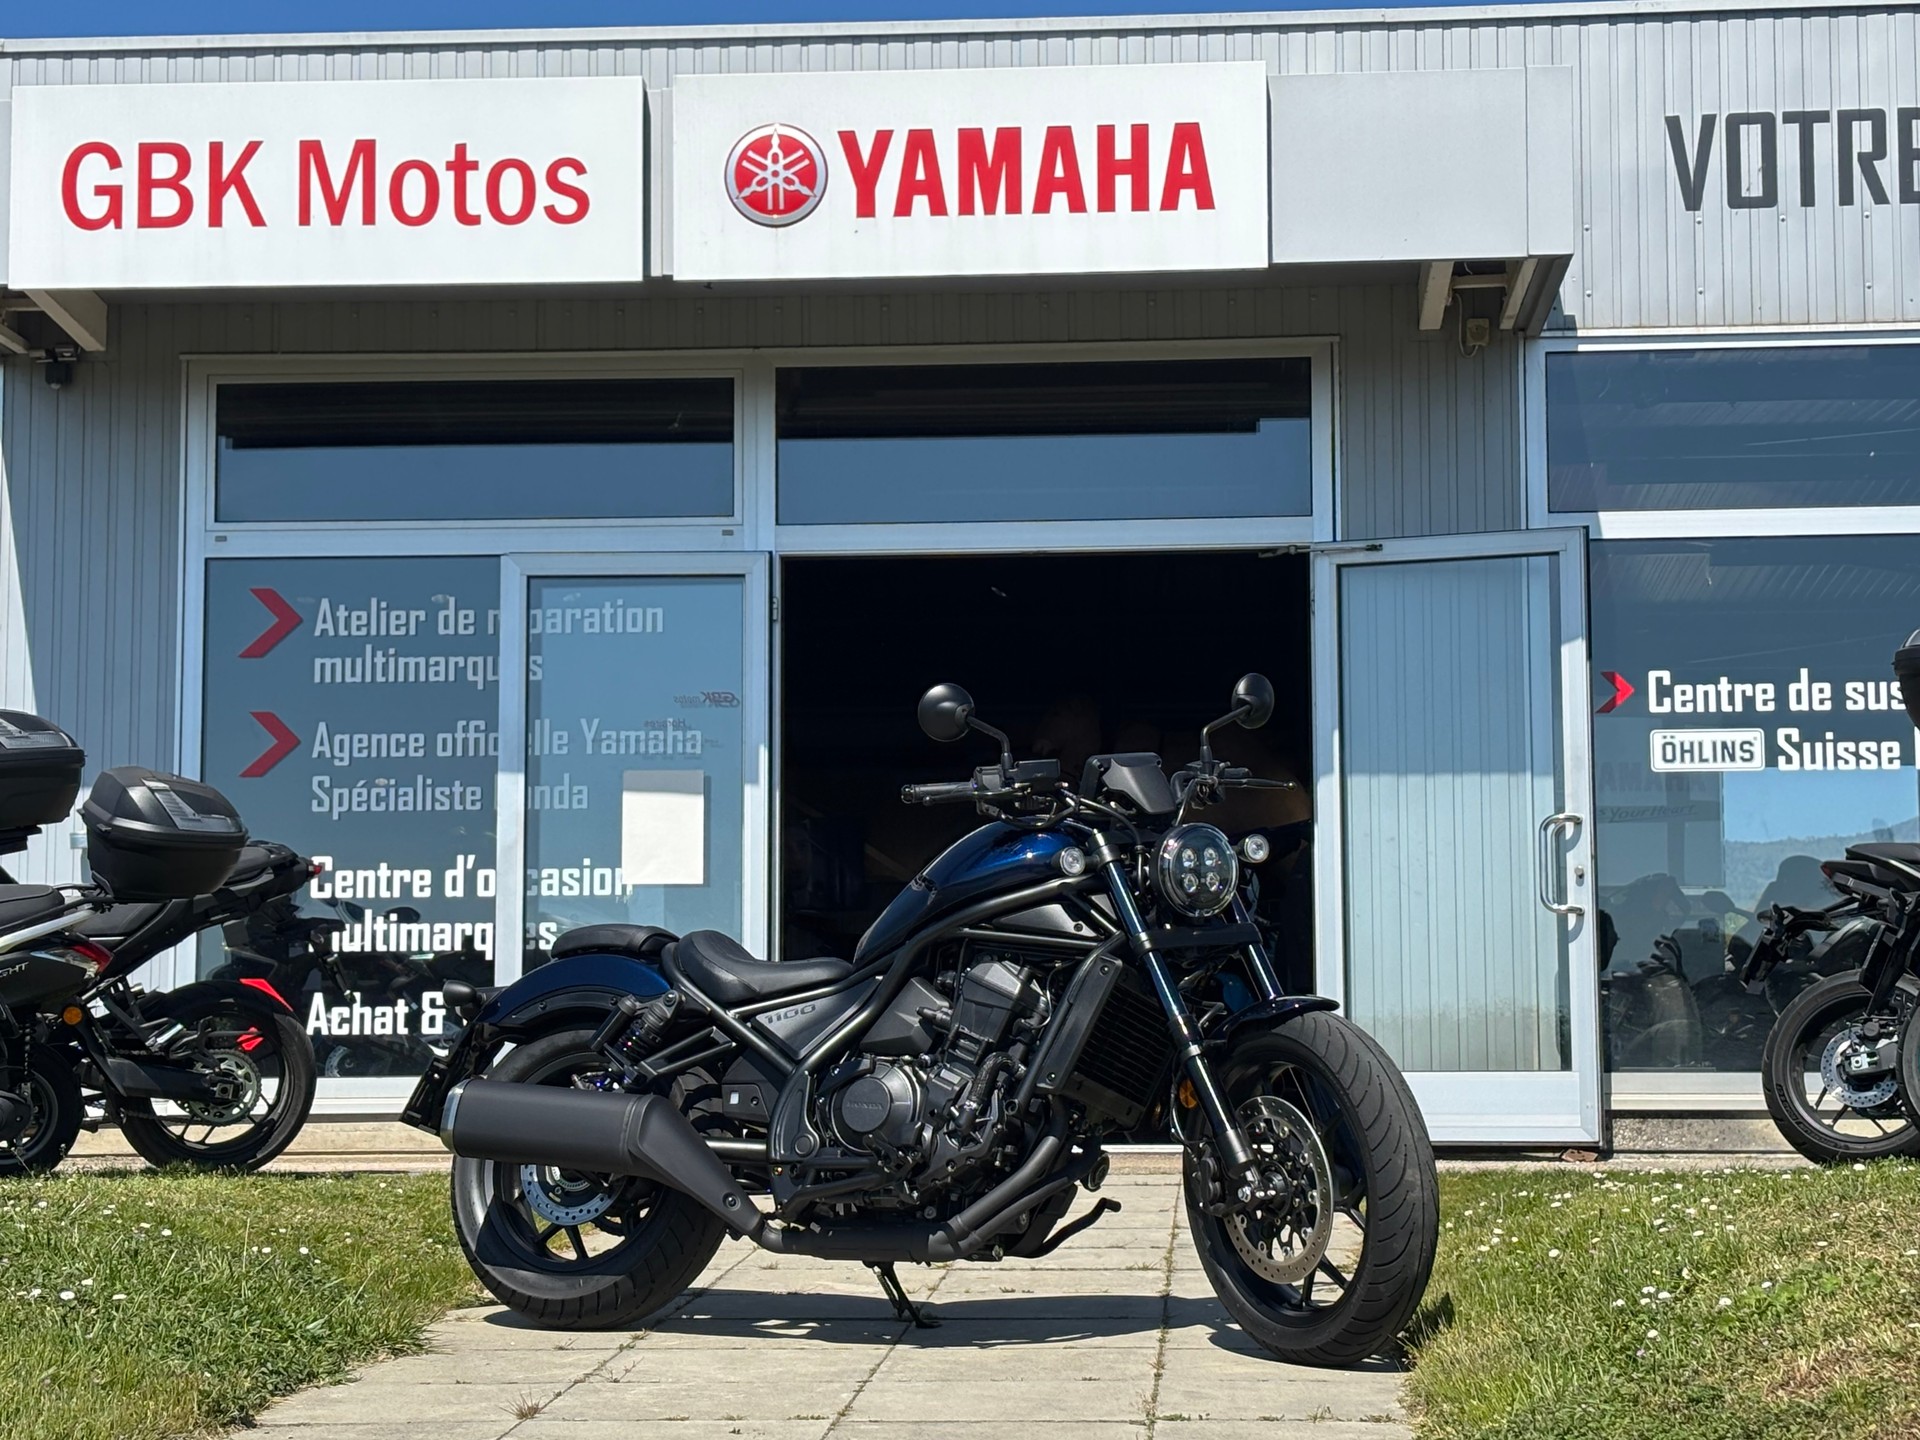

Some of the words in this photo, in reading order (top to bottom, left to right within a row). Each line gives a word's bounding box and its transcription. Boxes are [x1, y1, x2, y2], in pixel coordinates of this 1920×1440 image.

[837, 122, 1216, 218] YAMAHA
[1664, 107, 1920, 211] VOTRE
[61, 140, 268, 231] GBK
[298, 138, 590, 227] Motos
[314, 597, 426, 636] Atelier
[438, 596, 475, 635] de
[488, 599, 664, 643] rparation
[314, 644, 543, 690] multimarqus
[1648, 670, 1776, 714] Centre
[1788, 667, 1832, 712] de
[1845, 681, 1907, 711] sus
[312, 721, 425, 766] Agence
[580, 718, 702, 755] Yamaha
[1661, 735, 1756, 764] ÖHLINS
[1777, 727, 1901, 771] Suisse
[311, 774, 482, 820] Spécialiste
[310, 855, 432, 899] Centre
[306, 991, 410, 1036] Achat
[421, 991, 447, 1035] &
[764, 1003, 817, 1024] 1100
